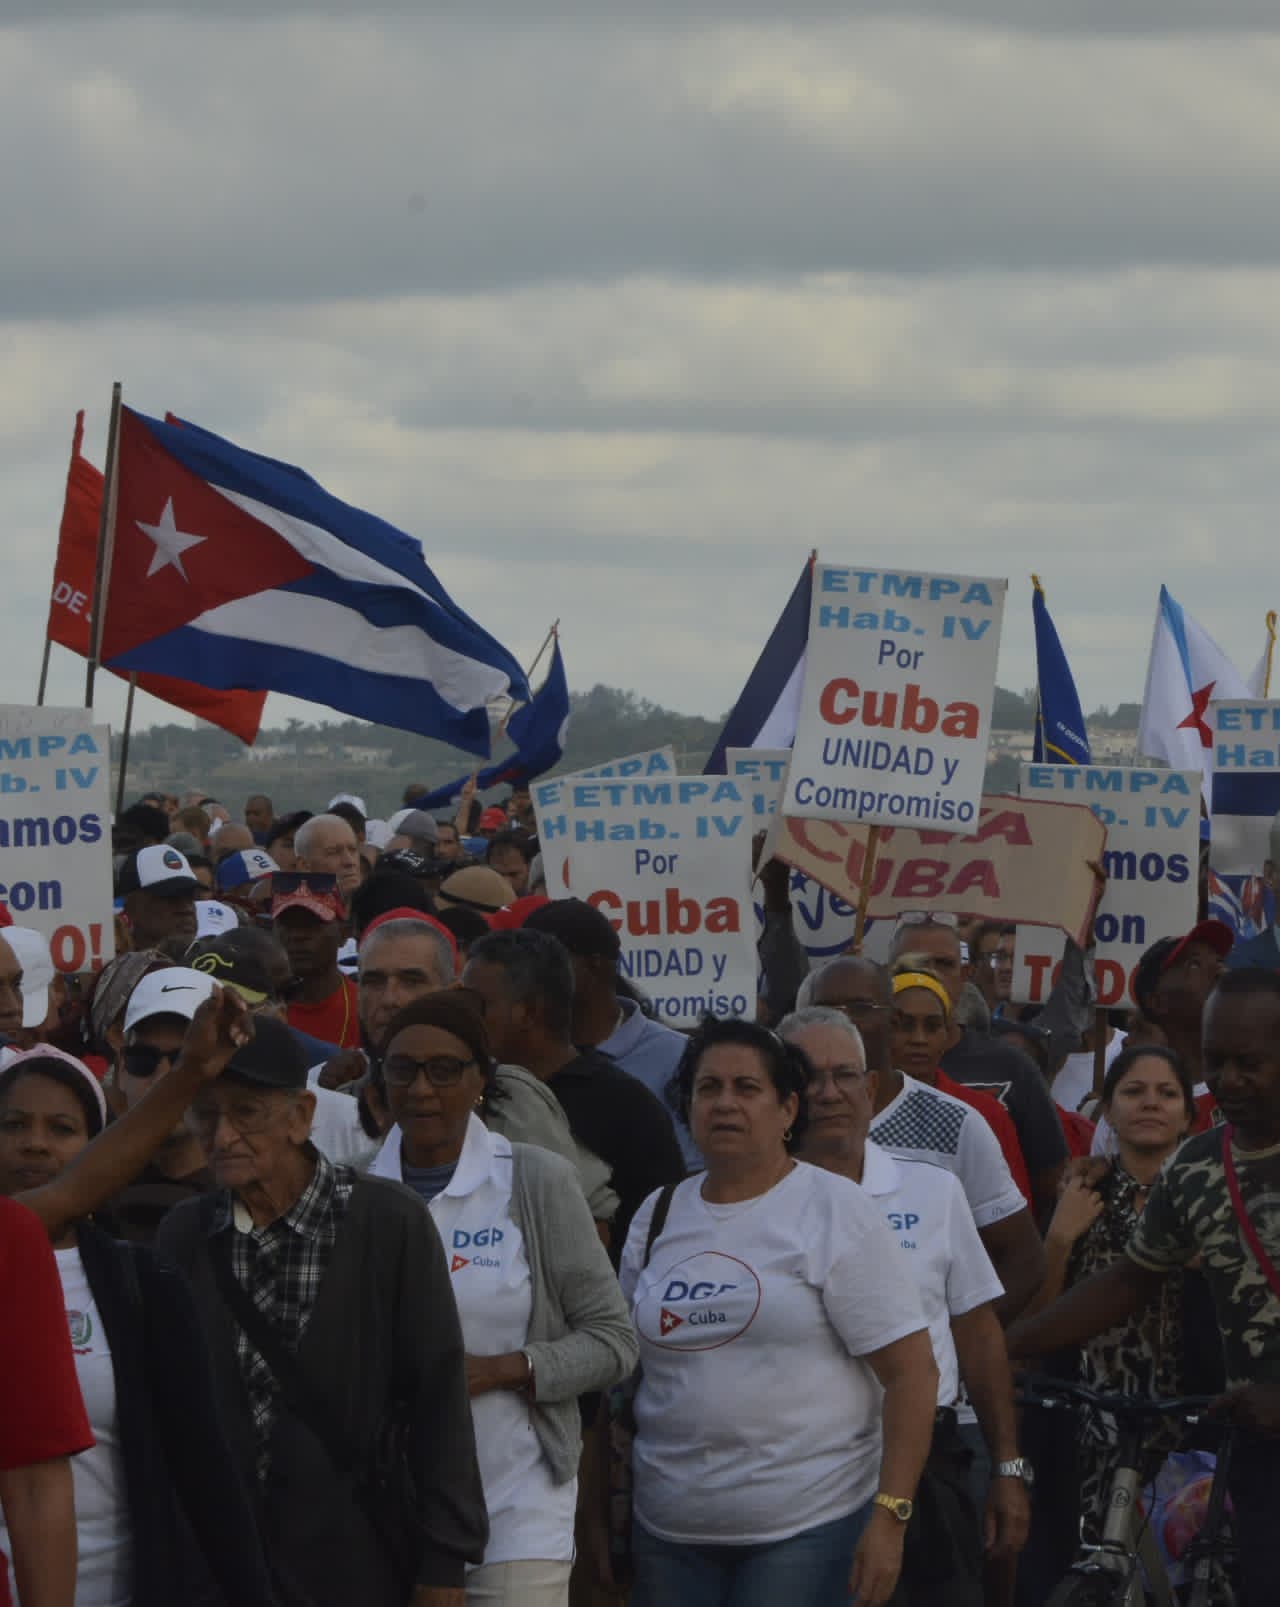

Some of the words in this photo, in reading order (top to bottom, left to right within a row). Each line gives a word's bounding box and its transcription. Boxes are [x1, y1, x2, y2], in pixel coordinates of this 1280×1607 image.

[53, 581, 88, 614] DE
[820, 569, 993, 606] ETMPA
[818, 605, 925, 635] Hab.
[941, 615, 991, 641] IV
[877, 639, 924, 670] Por
[819, 677, 980, 739] Cuba
[0, 733, 98, 759] MPA
[822, 737, 934, 776] UNIDAD
[941, 757, 959, 785] y
[0, 773, 40, 792] b.
[55, 767, 98, 790] IV
[1028, 767, 1190, 794] ETMPA
[573, 781, 742, 808] ETMPA
[794, 777, 974, 823] Compromiso
[575, 818, 680, 842] Hab.
[696, 815, 742, 838] IV
[1090, 803, 1129, 826] b.
[1145, 807, 1190, 829] IV
[635, 849, 678, 875] Por
[1104, 850, 1189, 883] mos
[1095, 913, 1146, 944] on
[50, 923, 103, 973] O!
[617, 948, 703, 977] NIDAD
[712, 953, 727, 982] y
[1024, 955, 1140, 1006] TD
[643, 989, 747, 1017] romiso
[887, 1213, 920, 1230] GP
[453, 1228, 504, 1248] DGP
[472, 1256, 501, 1269] Cuba
[688, 1310, 727, 1326] Cuba
